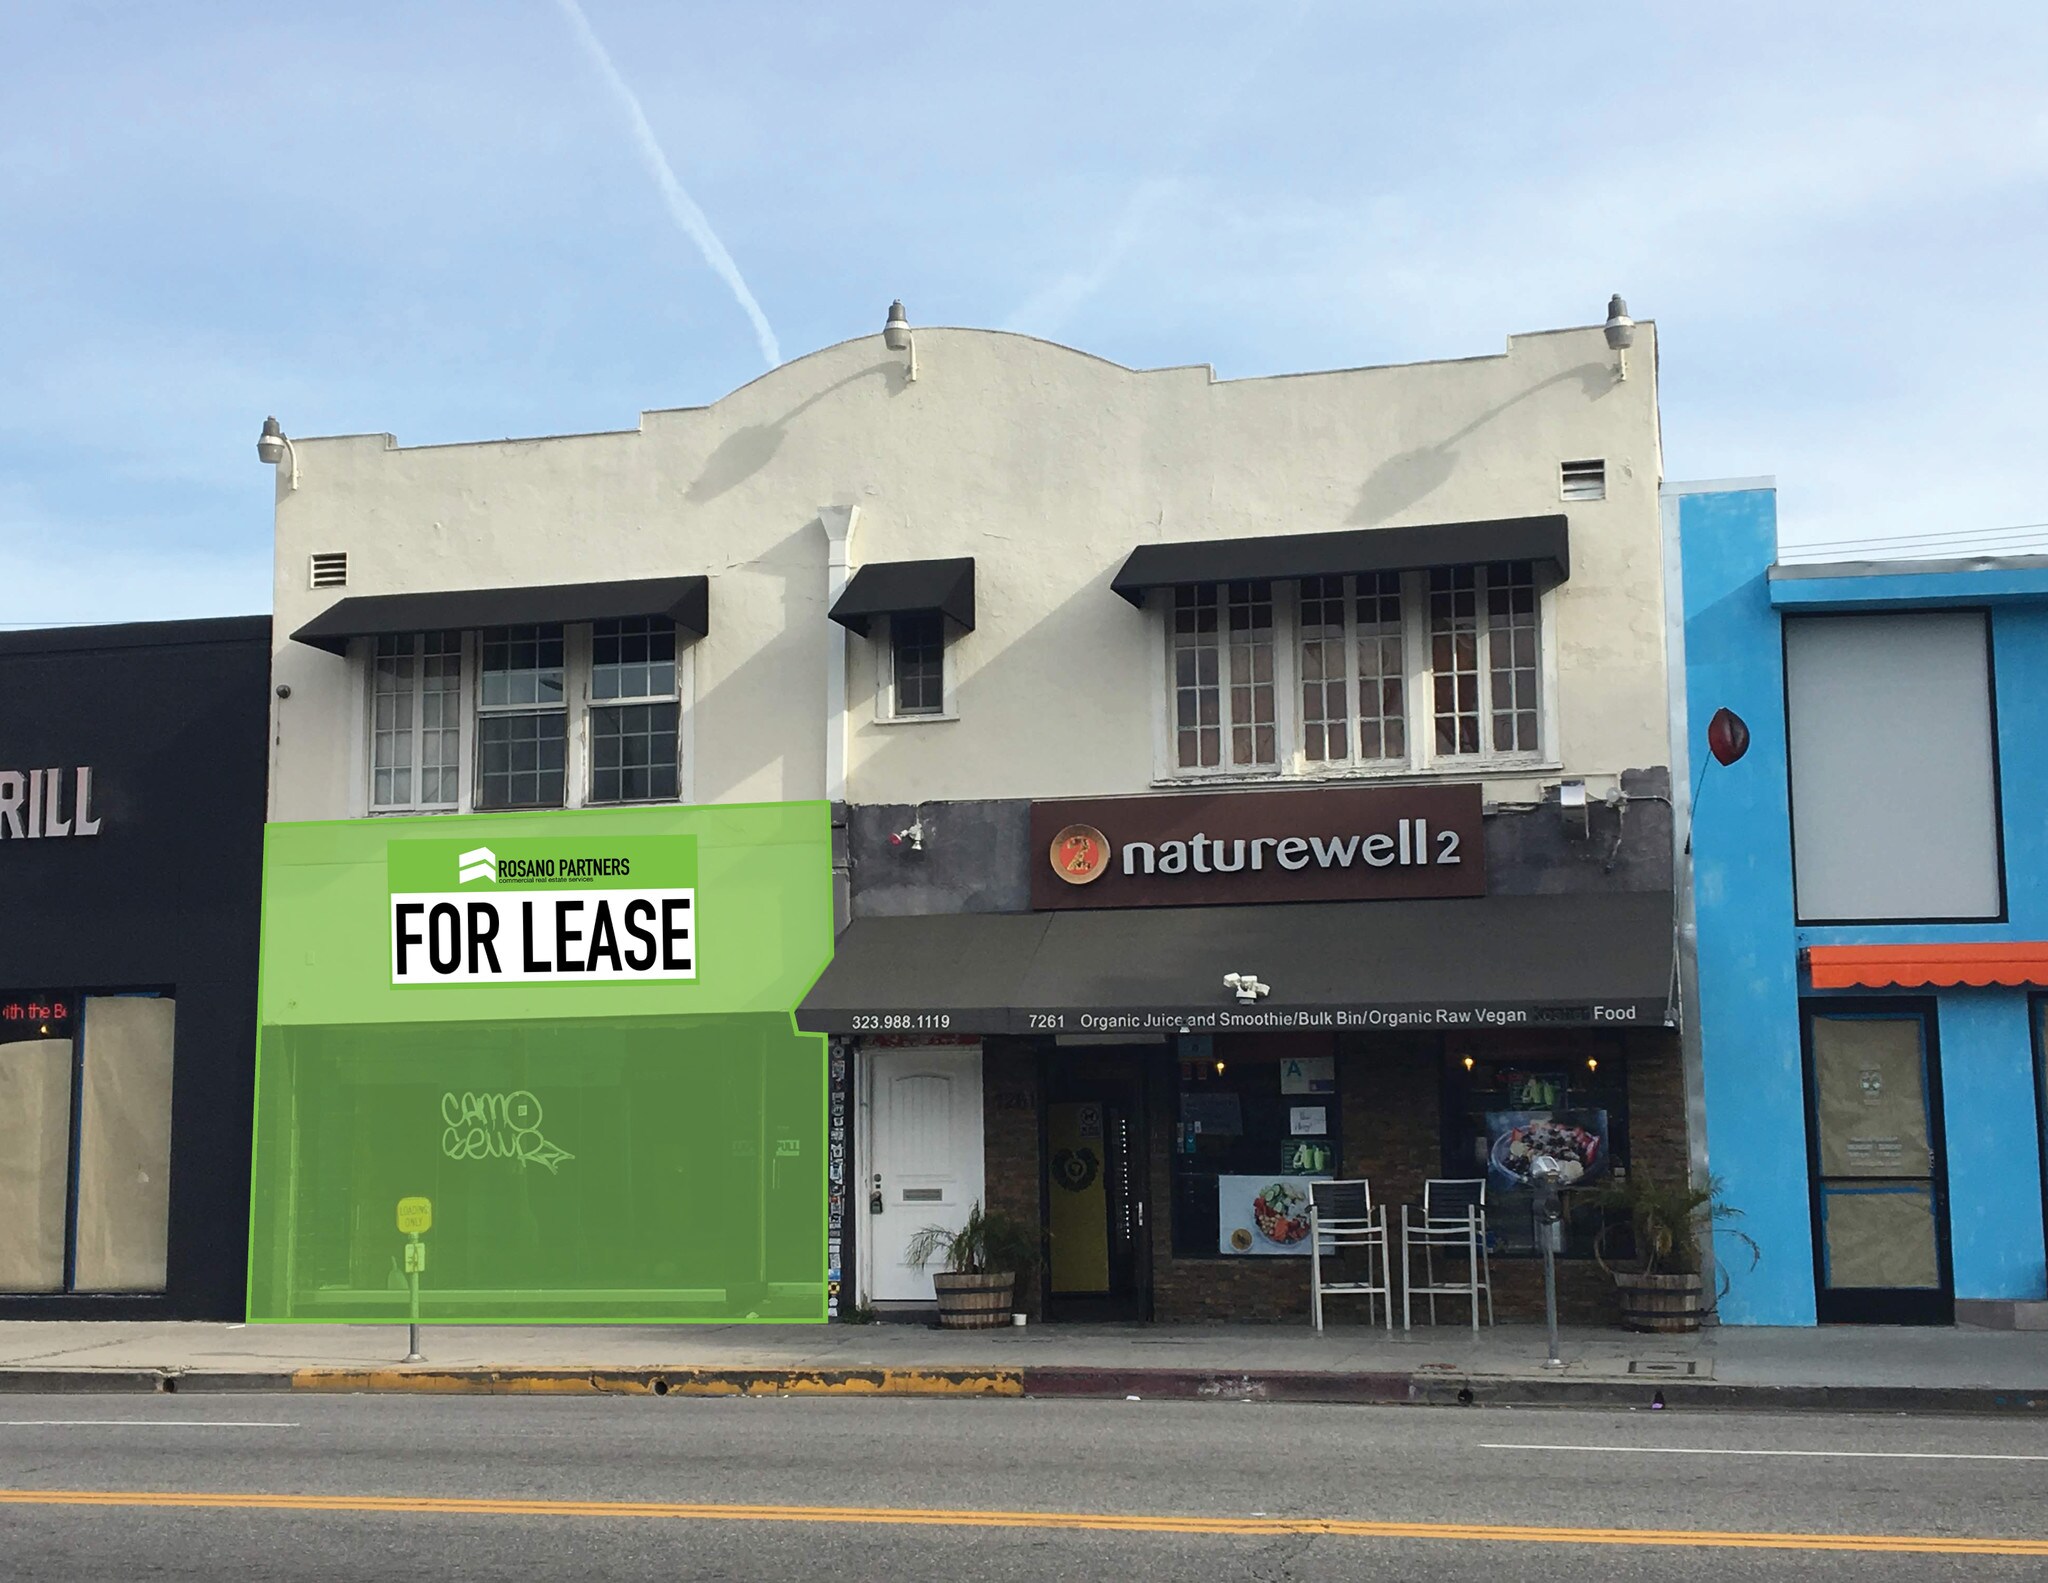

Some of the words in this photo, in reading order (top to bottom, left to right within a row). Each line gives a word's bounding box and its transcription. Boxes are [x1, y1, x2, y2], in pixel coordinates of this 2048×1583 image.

[0, 766, 102, 839] RILL
[1122, 817, 1428, 875] naturewell
[1436, 830, 1461, 864] 2
[28, 1003, 51, 1019] the
[852, 1014, 951, 1030] 323.988.1119
[1029, 1014, 1064, 1029] 7261
[1080, 1013, 1140, 1032] Organic
[1143, 1013, 1183, 1028] Juice
[1187, 1012, 1216, 1027] and
[1219, 1011, 1333, 1026] Smoothie/Bulk
[1336, 1009, 1432, 1027] Bin/Organic
[1436, 1009, 1472, 1023] Raw
[1474, 1008, 1527, 1026] Vegan
[1594, 1005, 1636, 1020] Food
[1286, 1060, 1301, 1077] A
